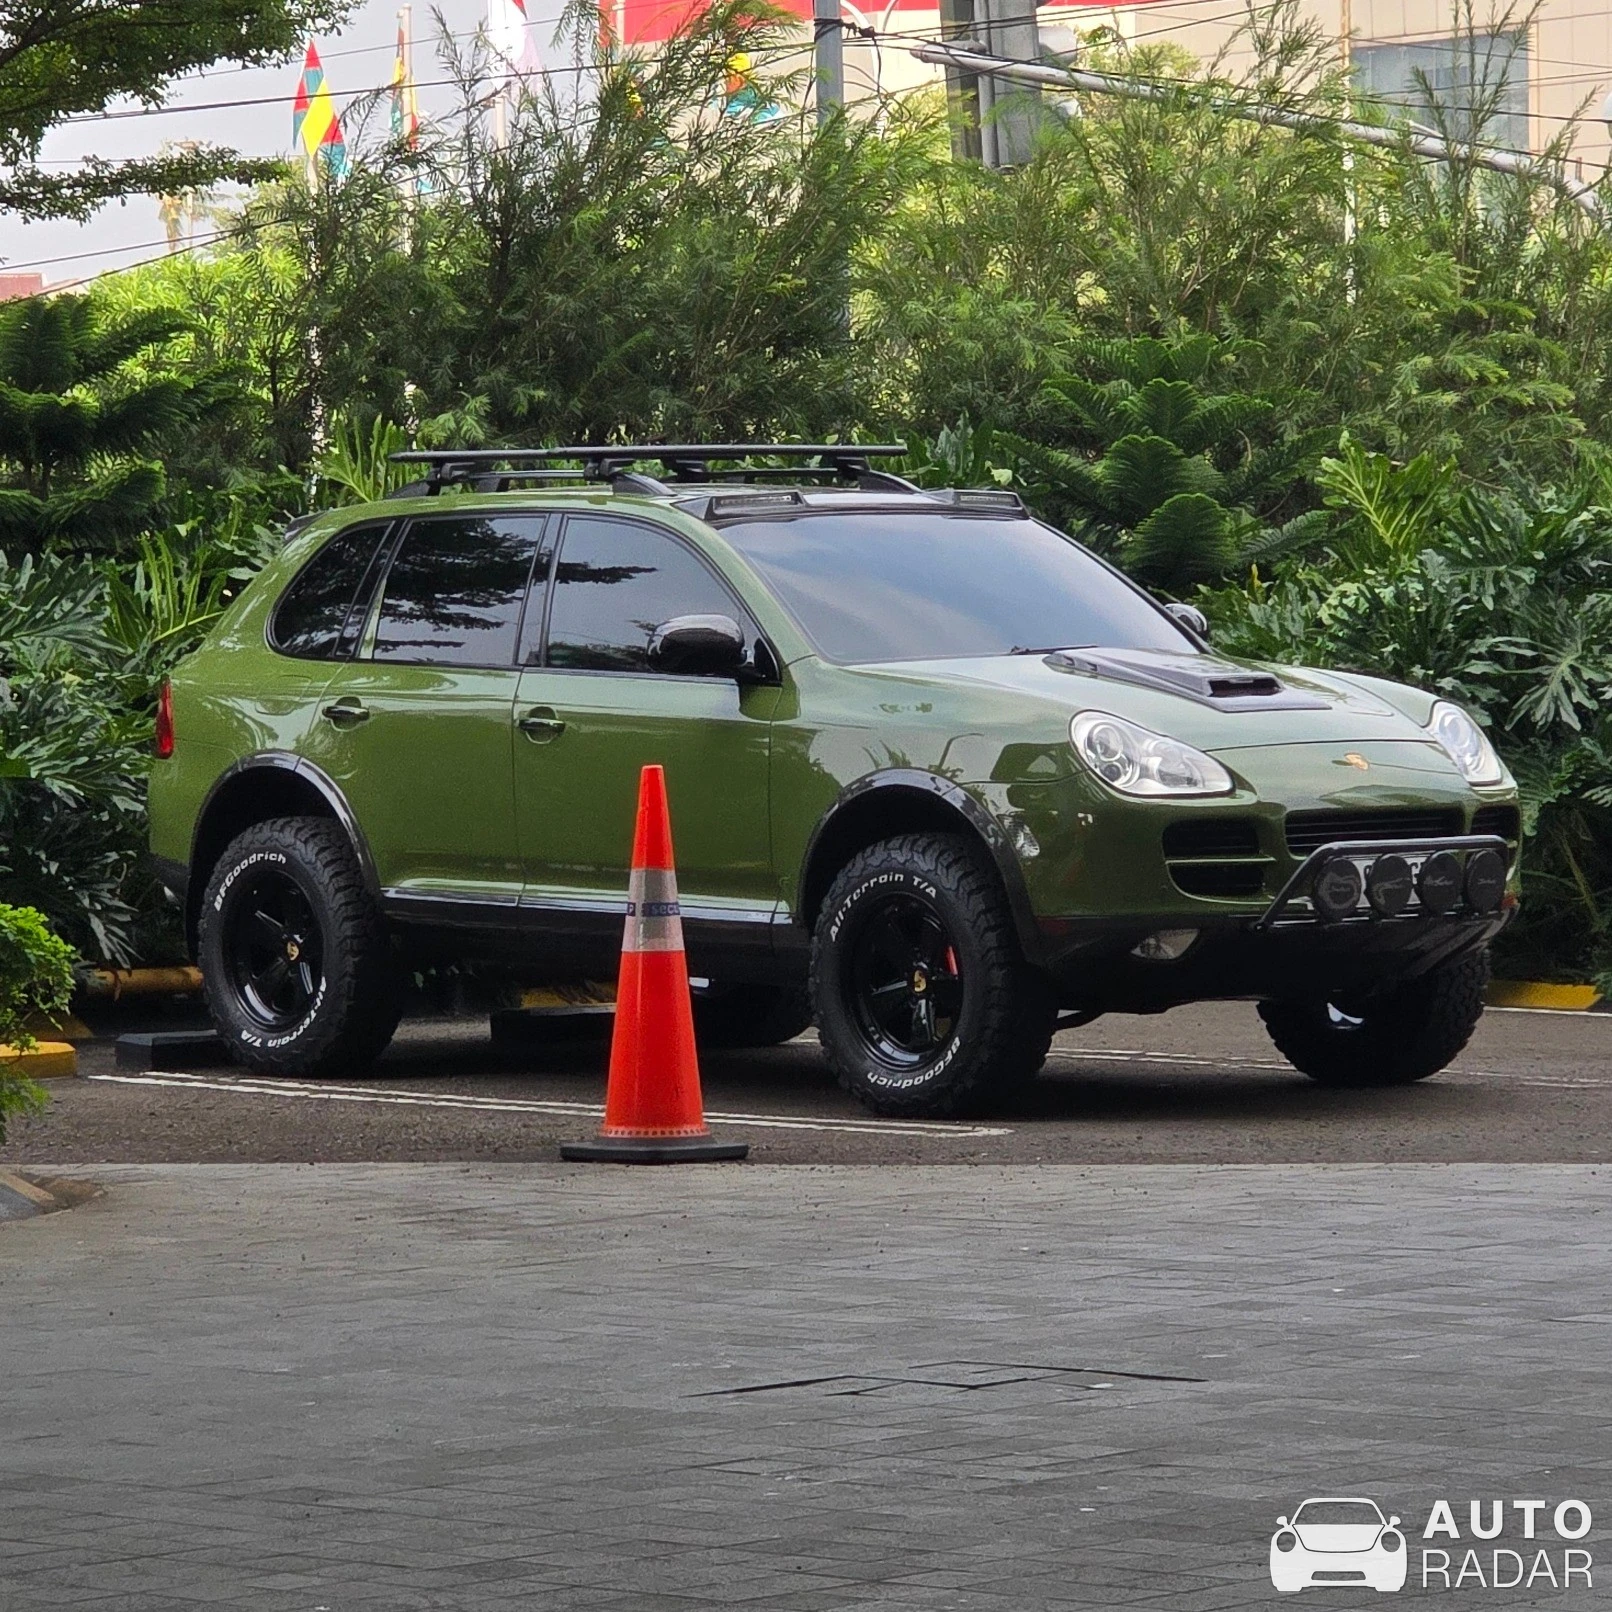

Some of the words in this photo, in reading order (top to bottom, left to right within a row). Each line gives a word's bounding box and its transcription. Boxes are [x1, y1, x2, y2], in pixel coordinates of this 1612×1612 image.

[214, 851, 286, 911] BFGoodrich
[830, 872, 904, 942] All-Terrain
[913, 875, 936, 898] T/A
[241, 1029, 262, 1048] T/A
[867, 1036, 960, 1089] BFGoodrich
